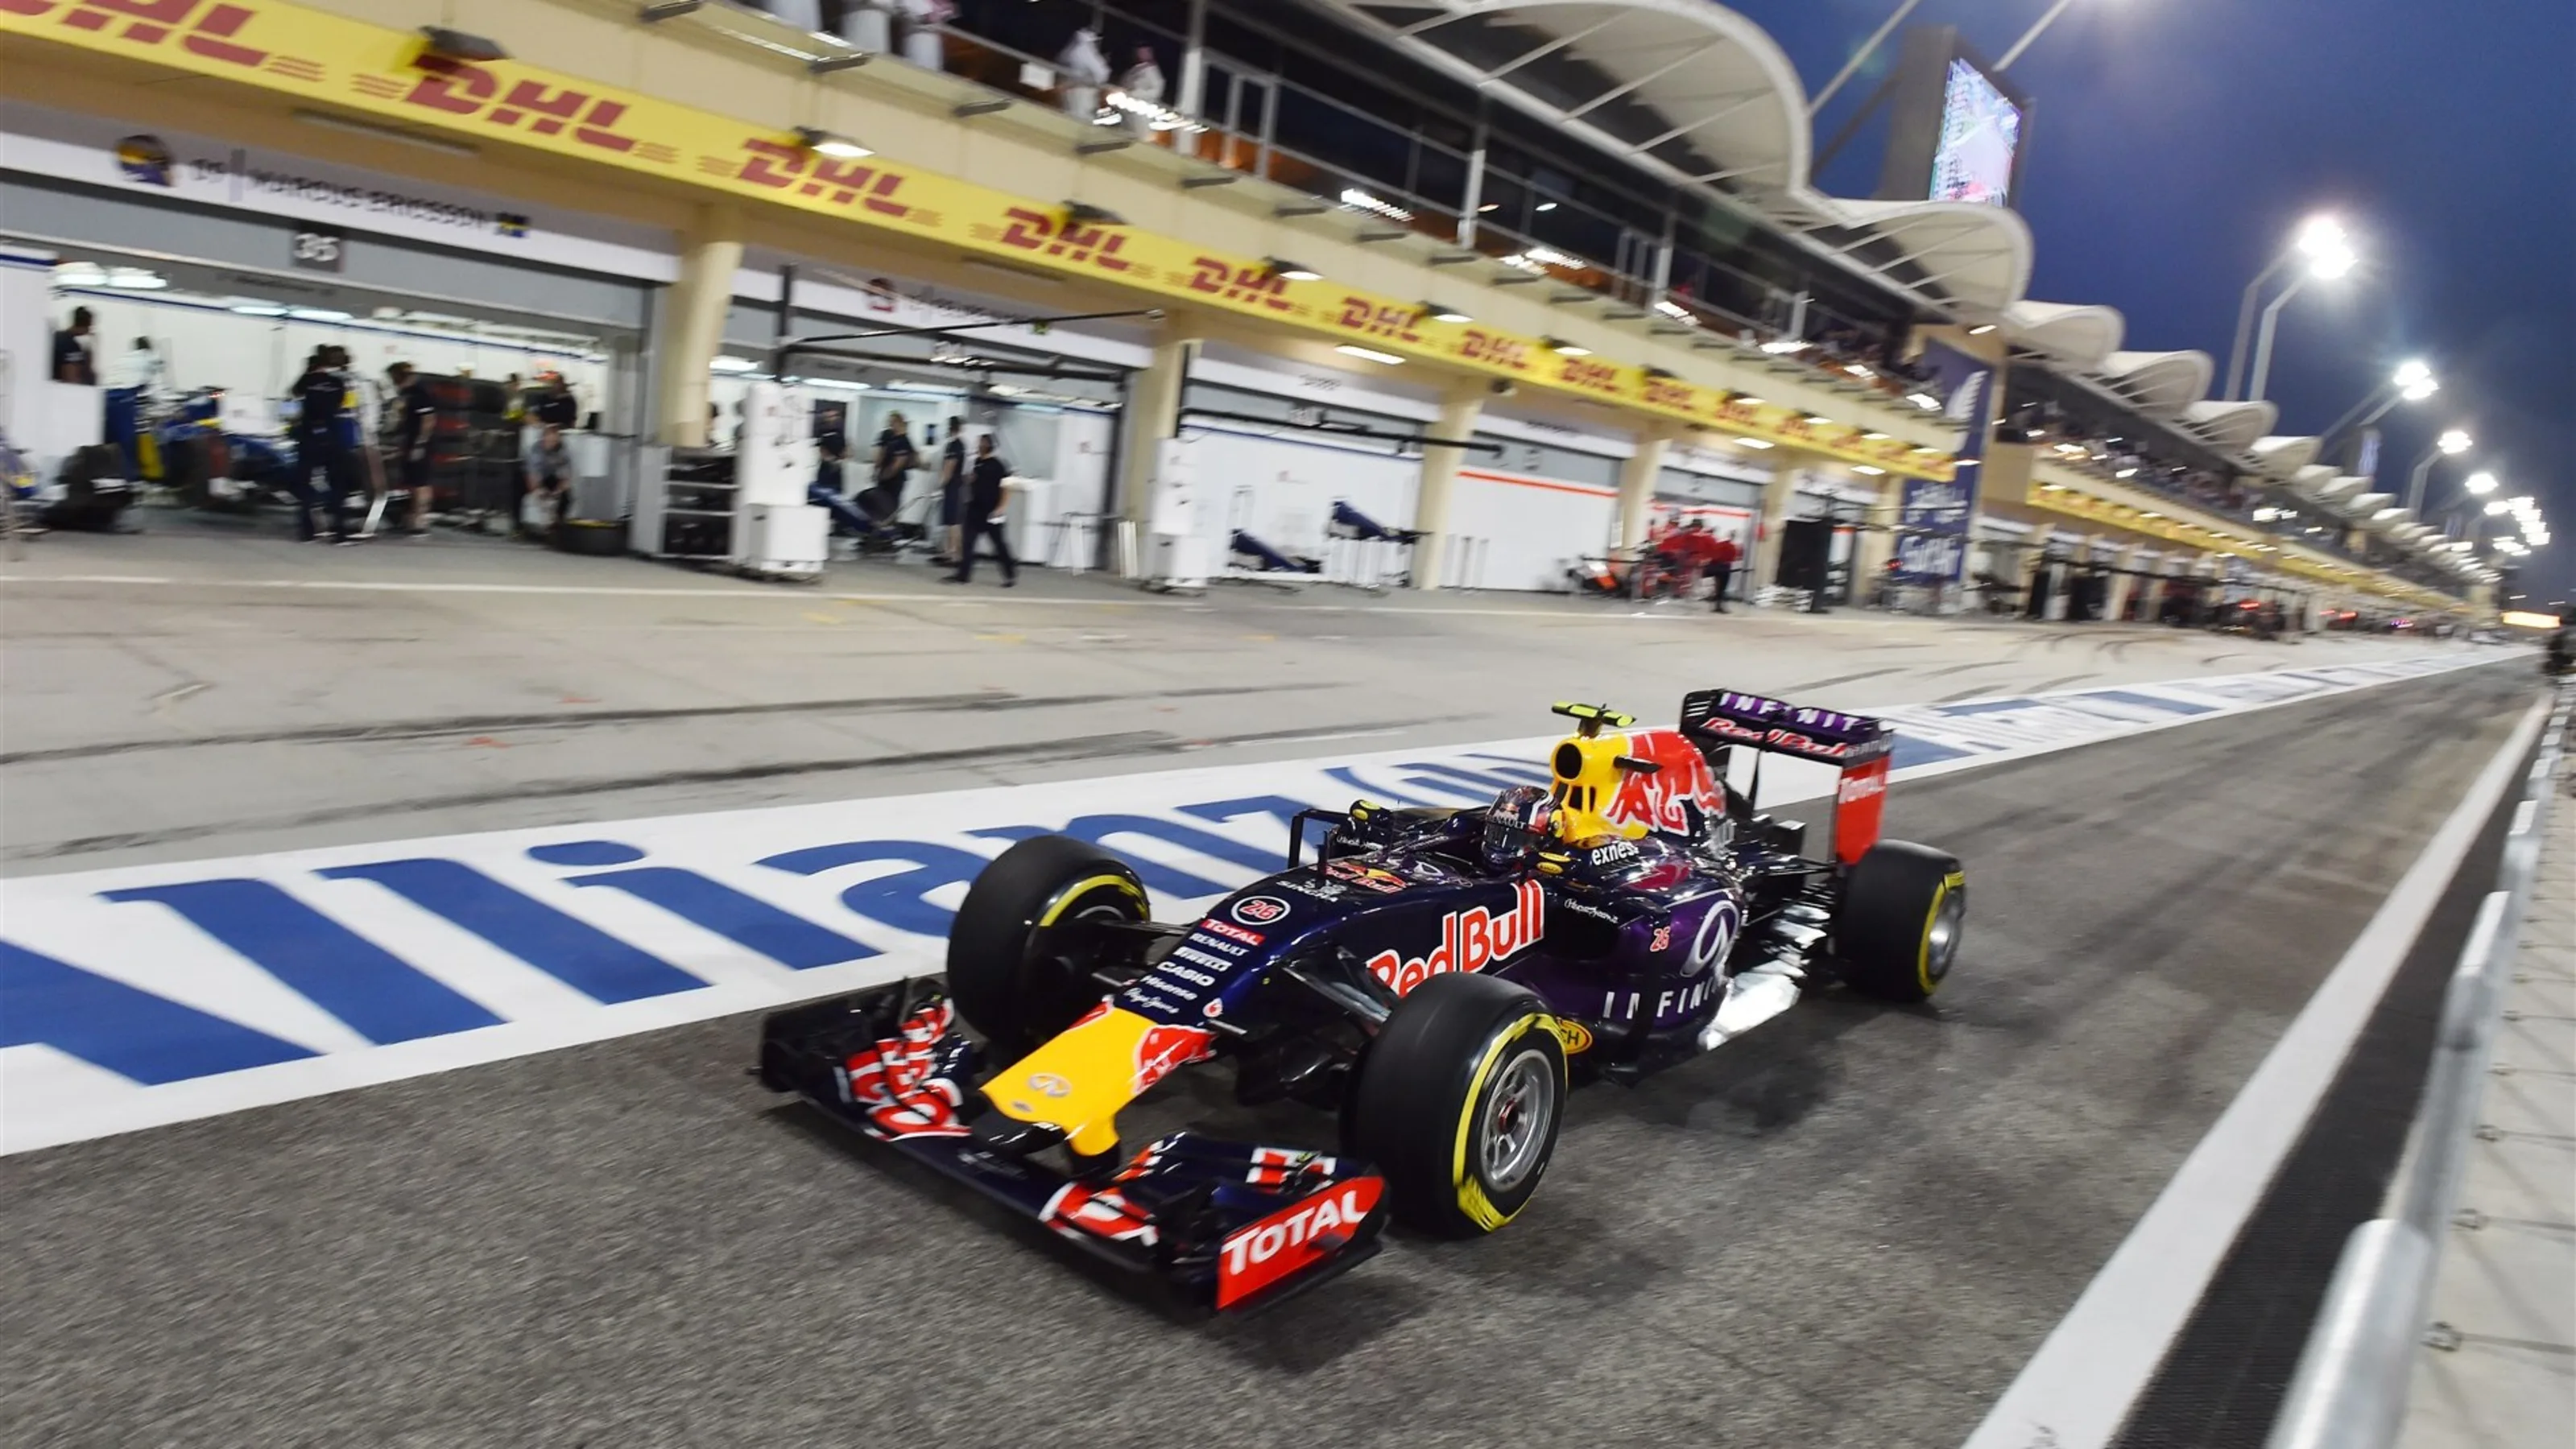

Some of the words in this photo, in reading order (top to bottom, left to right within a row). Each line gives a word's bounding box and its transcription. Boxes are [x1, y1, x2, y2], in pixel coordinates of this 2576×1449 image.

[405, 54, 635, 152] DHL
[736, 137, 911, 217] DHL
[293, 233, 341, 262] 35
[1000, 206, 1136, 272] DHL
[1189, 256, 1296, 312] DHL
[1338, 295, 1423, 343] DHL
[1460, 328, 1532, 369] DHL
[1559, 358, 1620, 392] DHL
[1238, 899, 1284, 921] 26
[1189, 932, 1250, 956] RENAULT
[1205, 918, 1259, 946] TOTAL
[1367, 906, 1458, 999] Red
[1458, 880, 1544, 973] Bull
[1650, 927, 1671, 952] 26
[1139, 974, 1198, 1001] Hisense
[1156, 961, 1216, 987] CASIO
[1222, 1190, 1368, 1276] TOTAL
